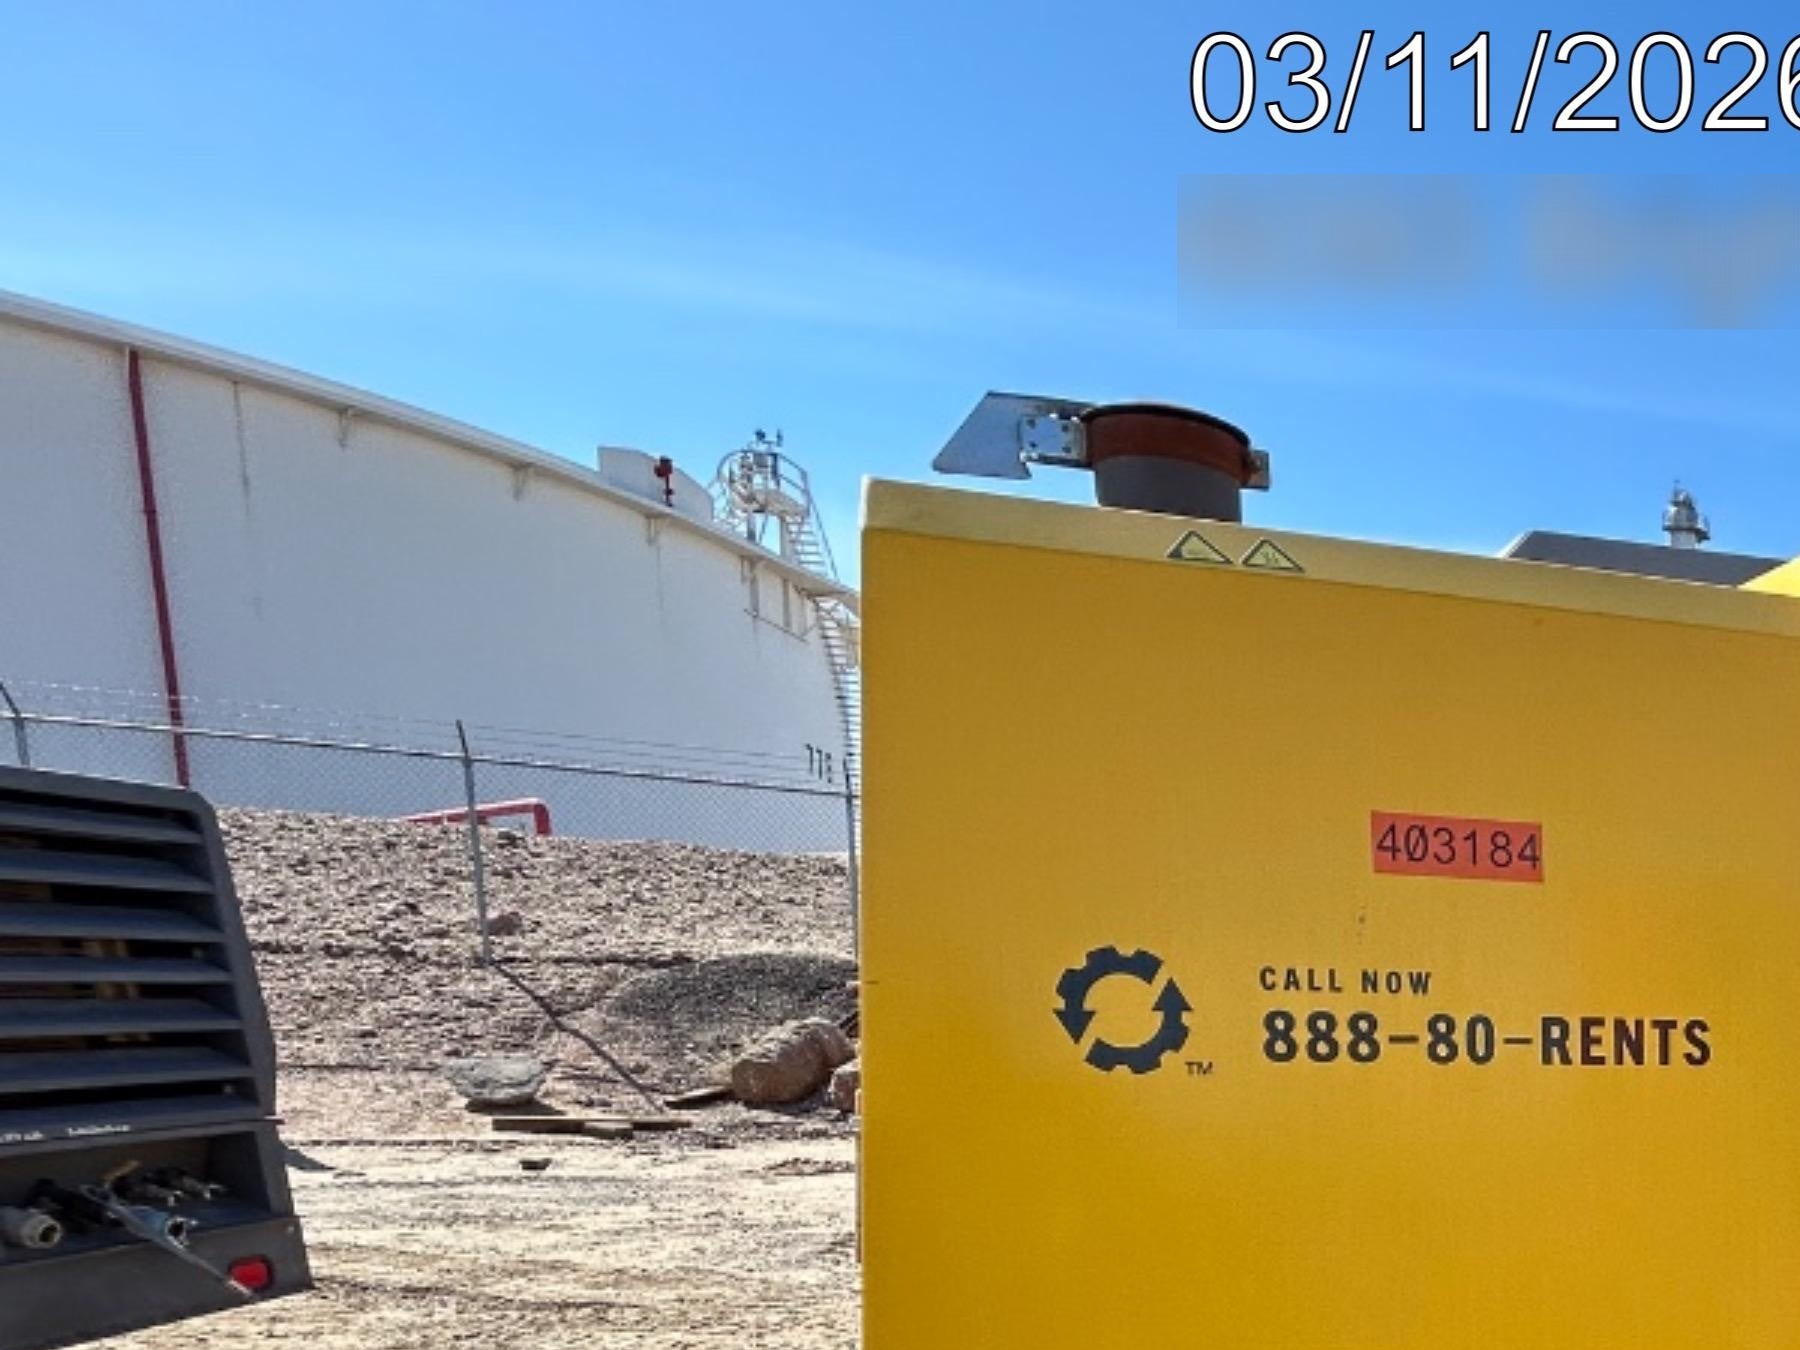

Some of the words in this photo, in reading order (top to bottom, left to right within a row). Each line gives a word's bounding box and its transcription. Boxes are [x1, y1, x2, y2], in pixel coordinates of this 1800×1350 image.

[1376, 822, 1540, 869] 403184
[1259, 966, 1343, 993] CALL
[1361, 969, 1432, 995] NOW
[1262, 1009, 1712, 1066] 888-80-RENTS
